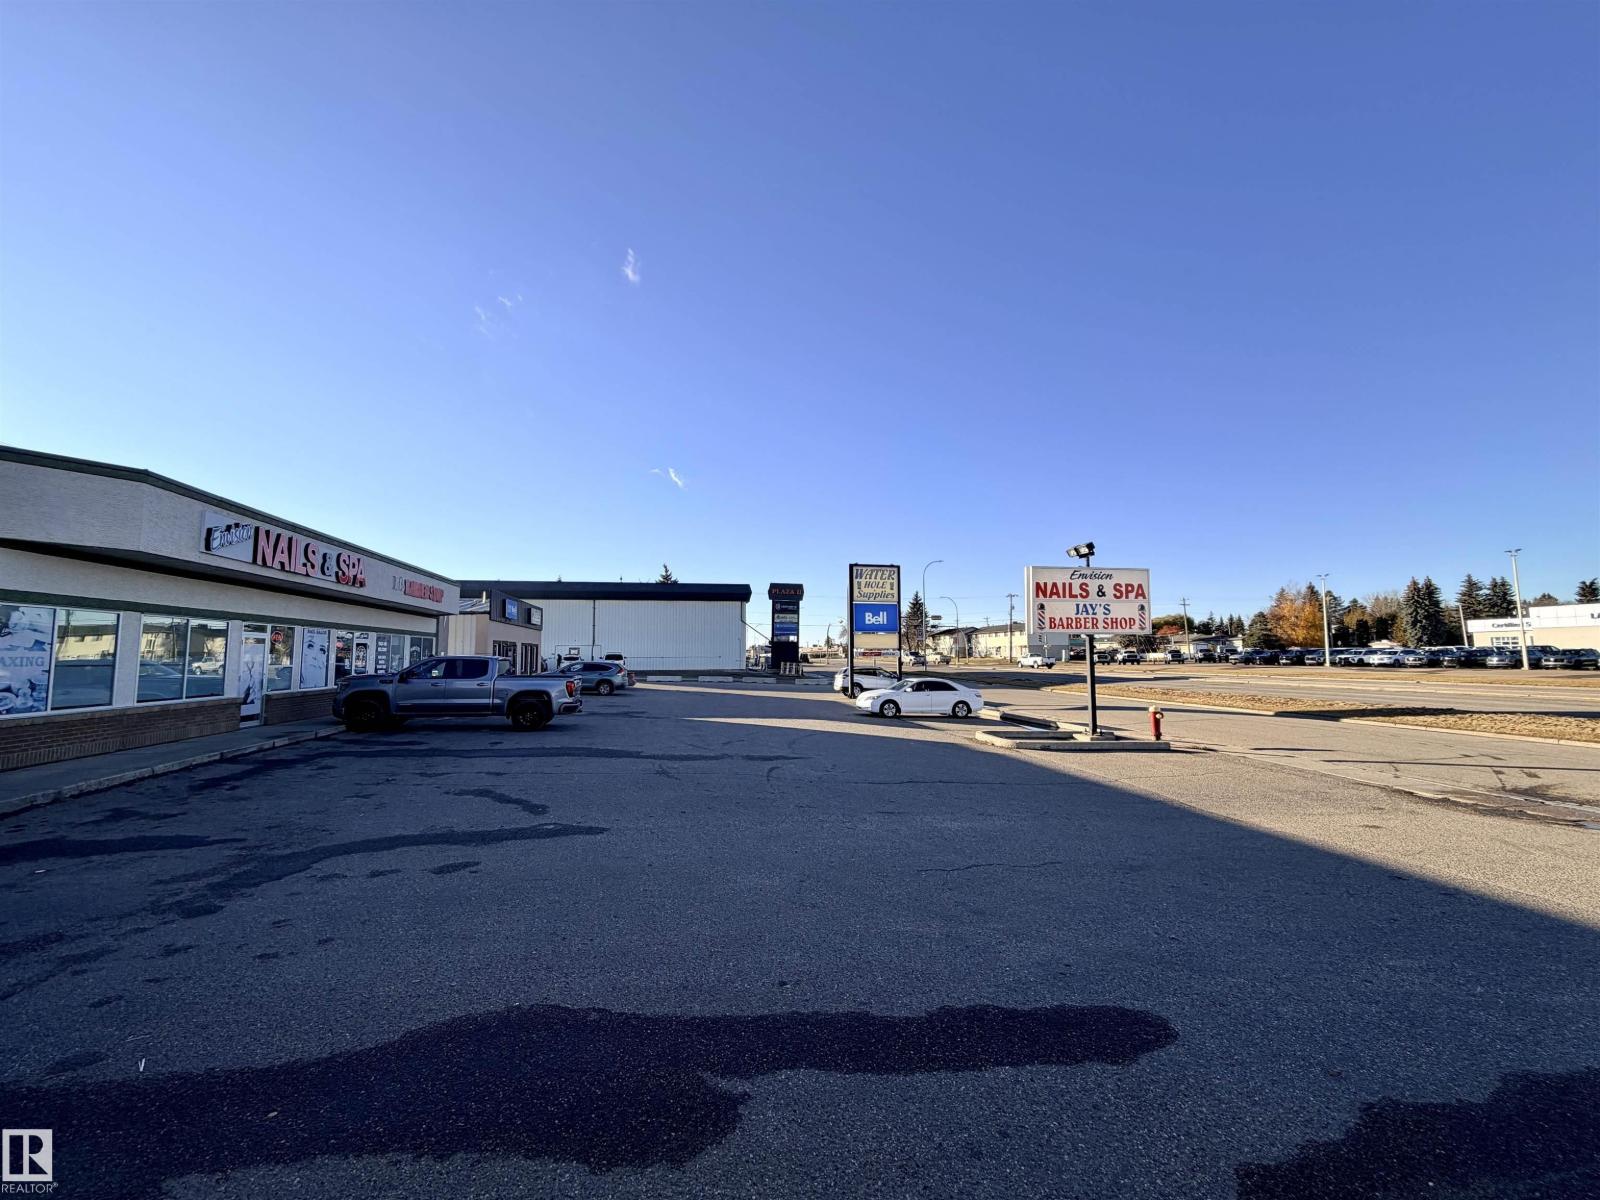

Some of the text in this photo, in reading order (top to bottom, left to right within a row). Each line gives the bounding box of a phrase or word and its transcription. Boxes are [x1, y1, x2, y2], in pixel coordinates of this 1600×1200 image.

[205, 522, 253, 551] Envision
[254, 526, 319, 577] NAILS
[322, 552, 334, 576] &
[337, 552, 367, 588] SPA
[854, 568, 896, 581] WATER
[1069, 569, 1114, 581] Envision
[863, 580, 888, 590] HOLE
[1035, 581, 1147, 600] NAILS & SPA
[856, 589, 895, 601] Supplies
[1074, 603, 1111, 616] JAY'S
[864, 611, 887, 625] Bell
[1048, 616, 1136, 630] BARBER SHOP
